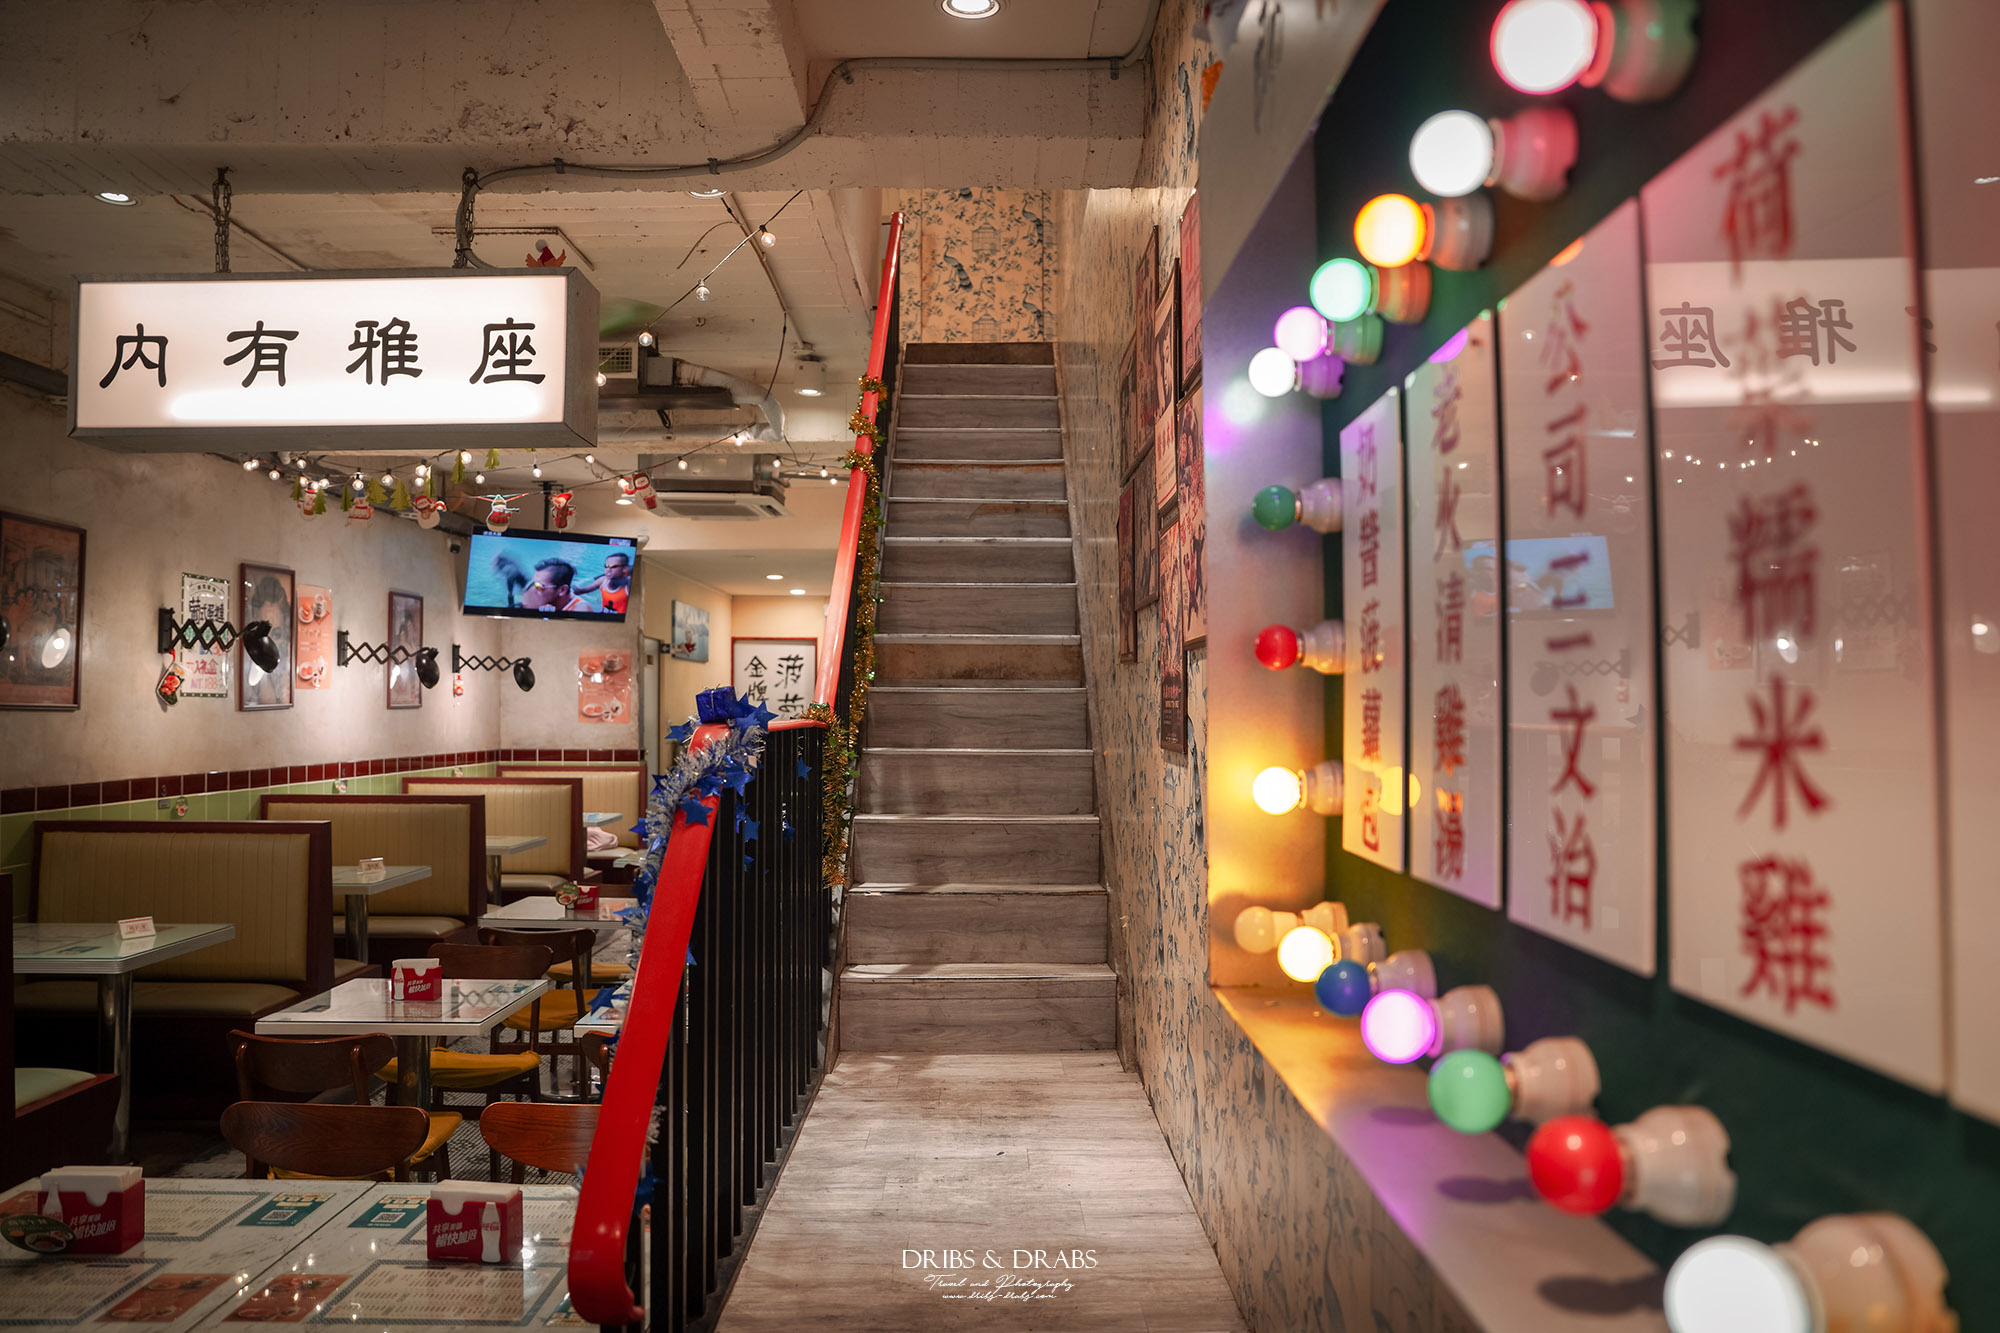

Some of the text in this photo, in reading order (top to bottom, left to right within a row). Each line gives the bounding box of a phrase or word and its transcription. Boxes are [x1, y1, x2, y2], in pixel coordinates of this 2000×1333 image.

[744, 655, 769, 702] 金牌
[1540, 280, 1600, 932] 公司三文治
